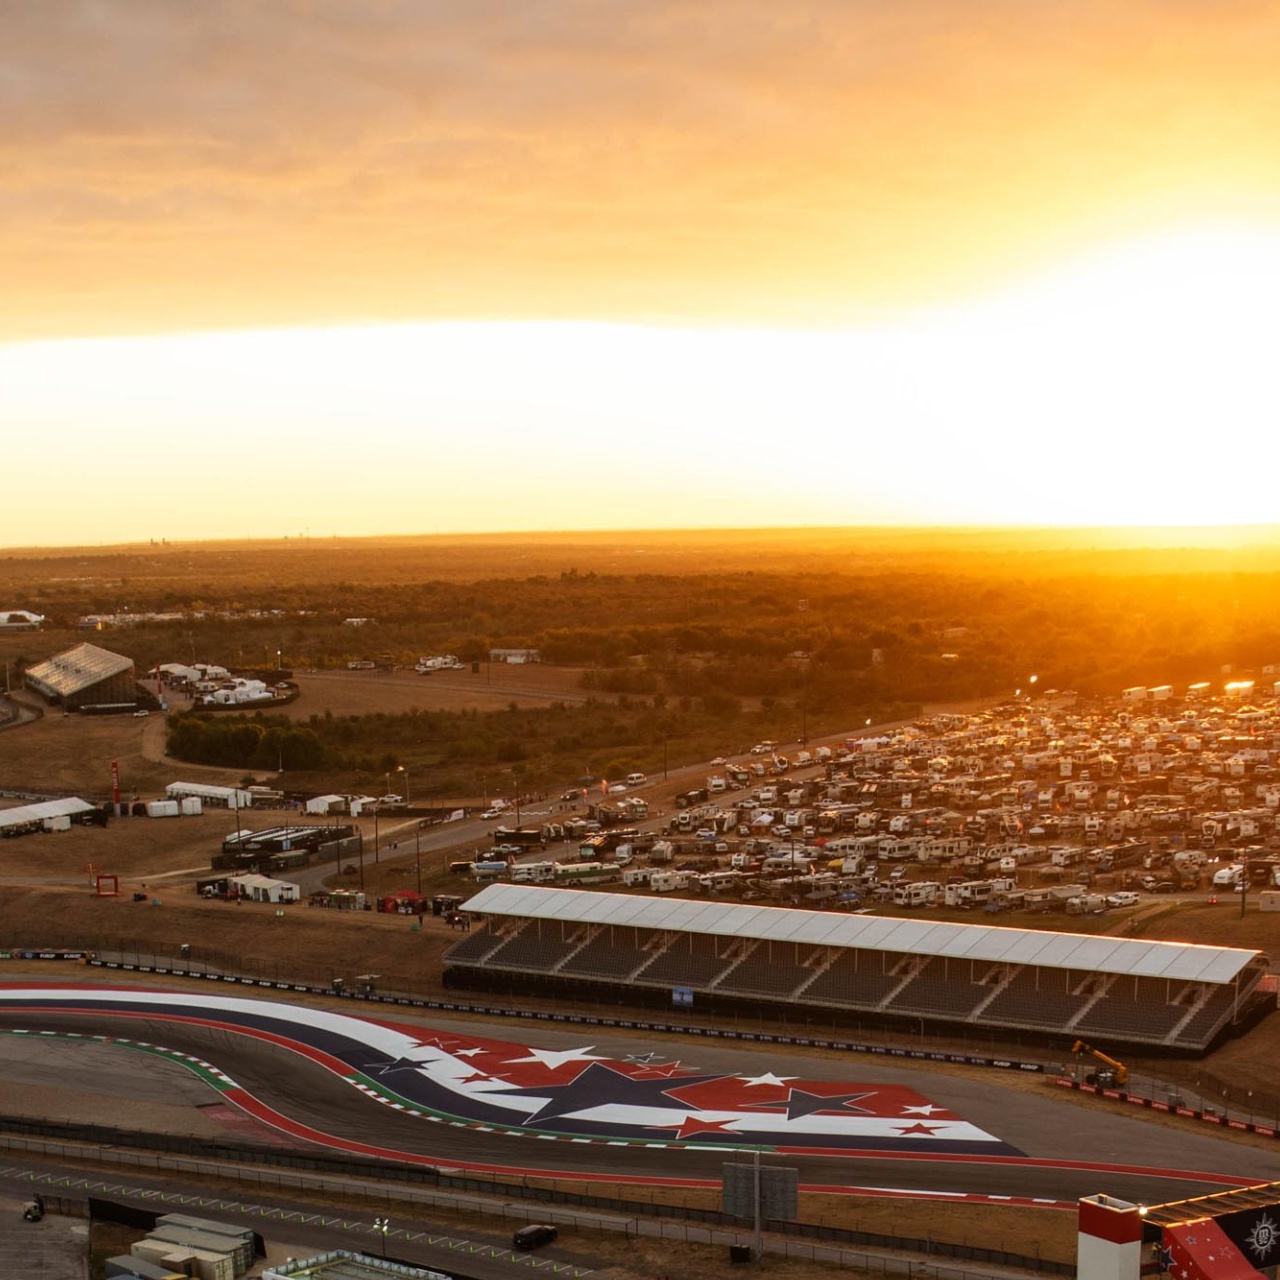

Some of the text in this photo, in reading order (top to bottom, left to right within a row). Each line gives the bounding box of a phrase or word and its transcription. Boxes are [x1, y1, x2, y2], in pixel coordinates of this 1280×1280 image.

[1056, 1078, 1072, 1087] Lenovo
[1080, 1083, 1095, 1092] Lenovo
[1104, 1088, 1119, 1098] Lenovo
[1127, 1094, 1143, 1103] Lenovo
[1152, 1101, 1168, 1110] Lenovo
[1177, 1108, 1194, 1117] Lenovo
[1203, 1114, 1220, 1123] Lenovo
[1228, 1120, 1246, 1129] Lenovo
[1255, 1126, 1273, 1136] Lenovo
